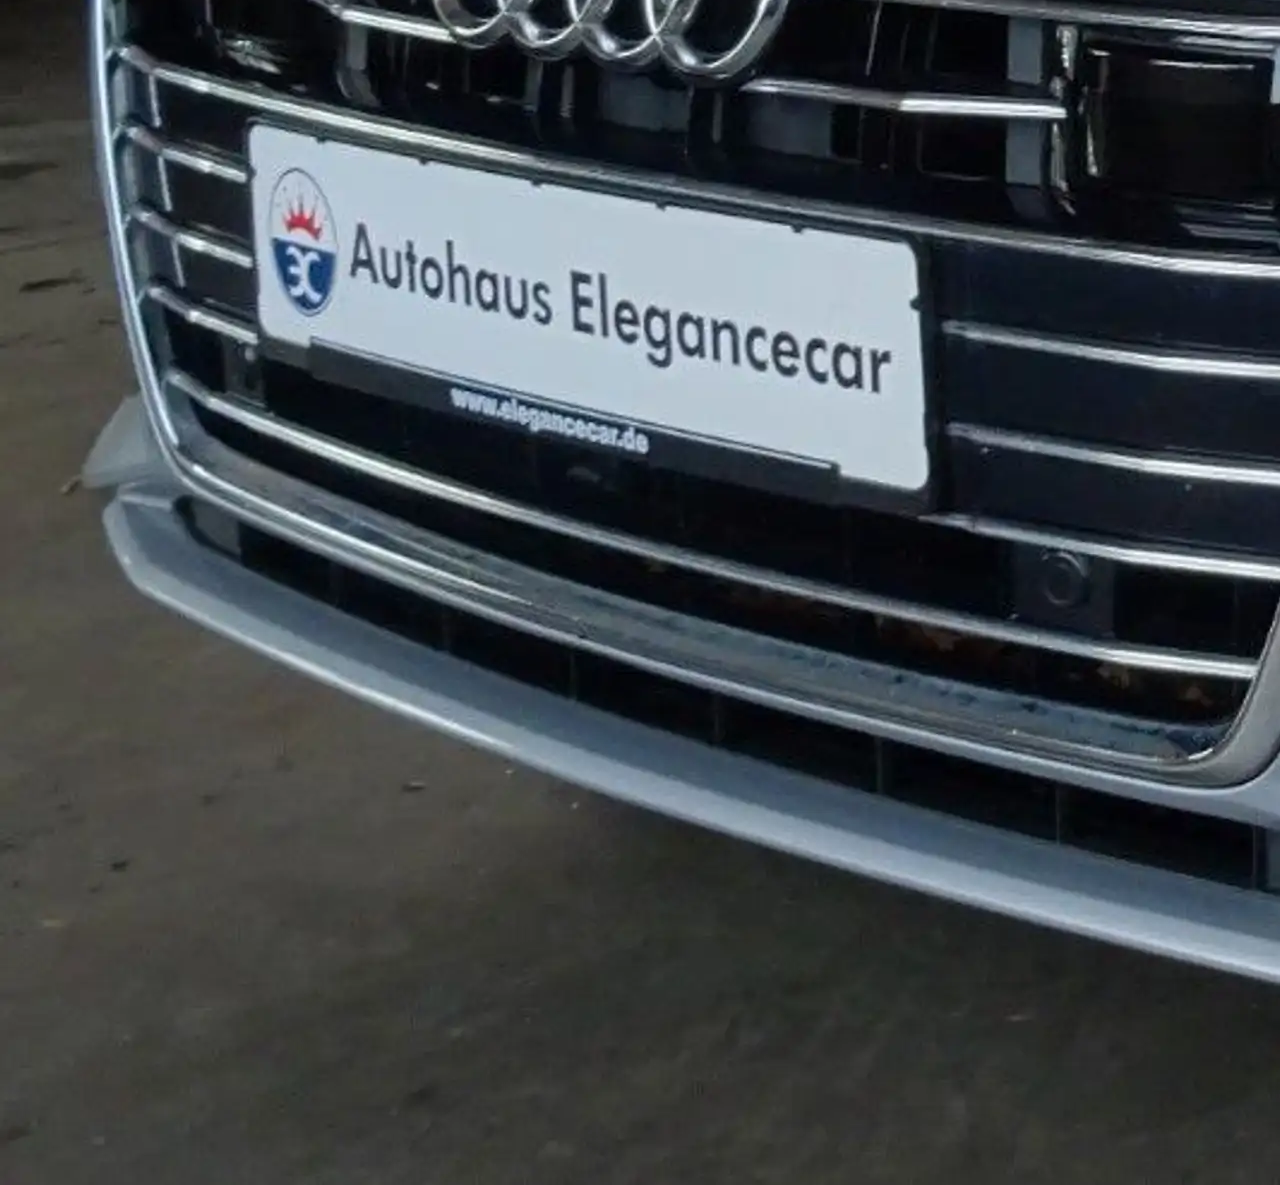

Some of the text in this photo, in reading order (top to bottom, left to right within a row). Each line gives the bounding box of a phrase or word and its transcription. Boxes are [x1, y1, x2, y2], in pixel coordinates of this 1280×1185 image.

[349, 223, 891, 393] Autohaus Elegancecar
[450, 387, 649, 454] www.elegancecar.de
